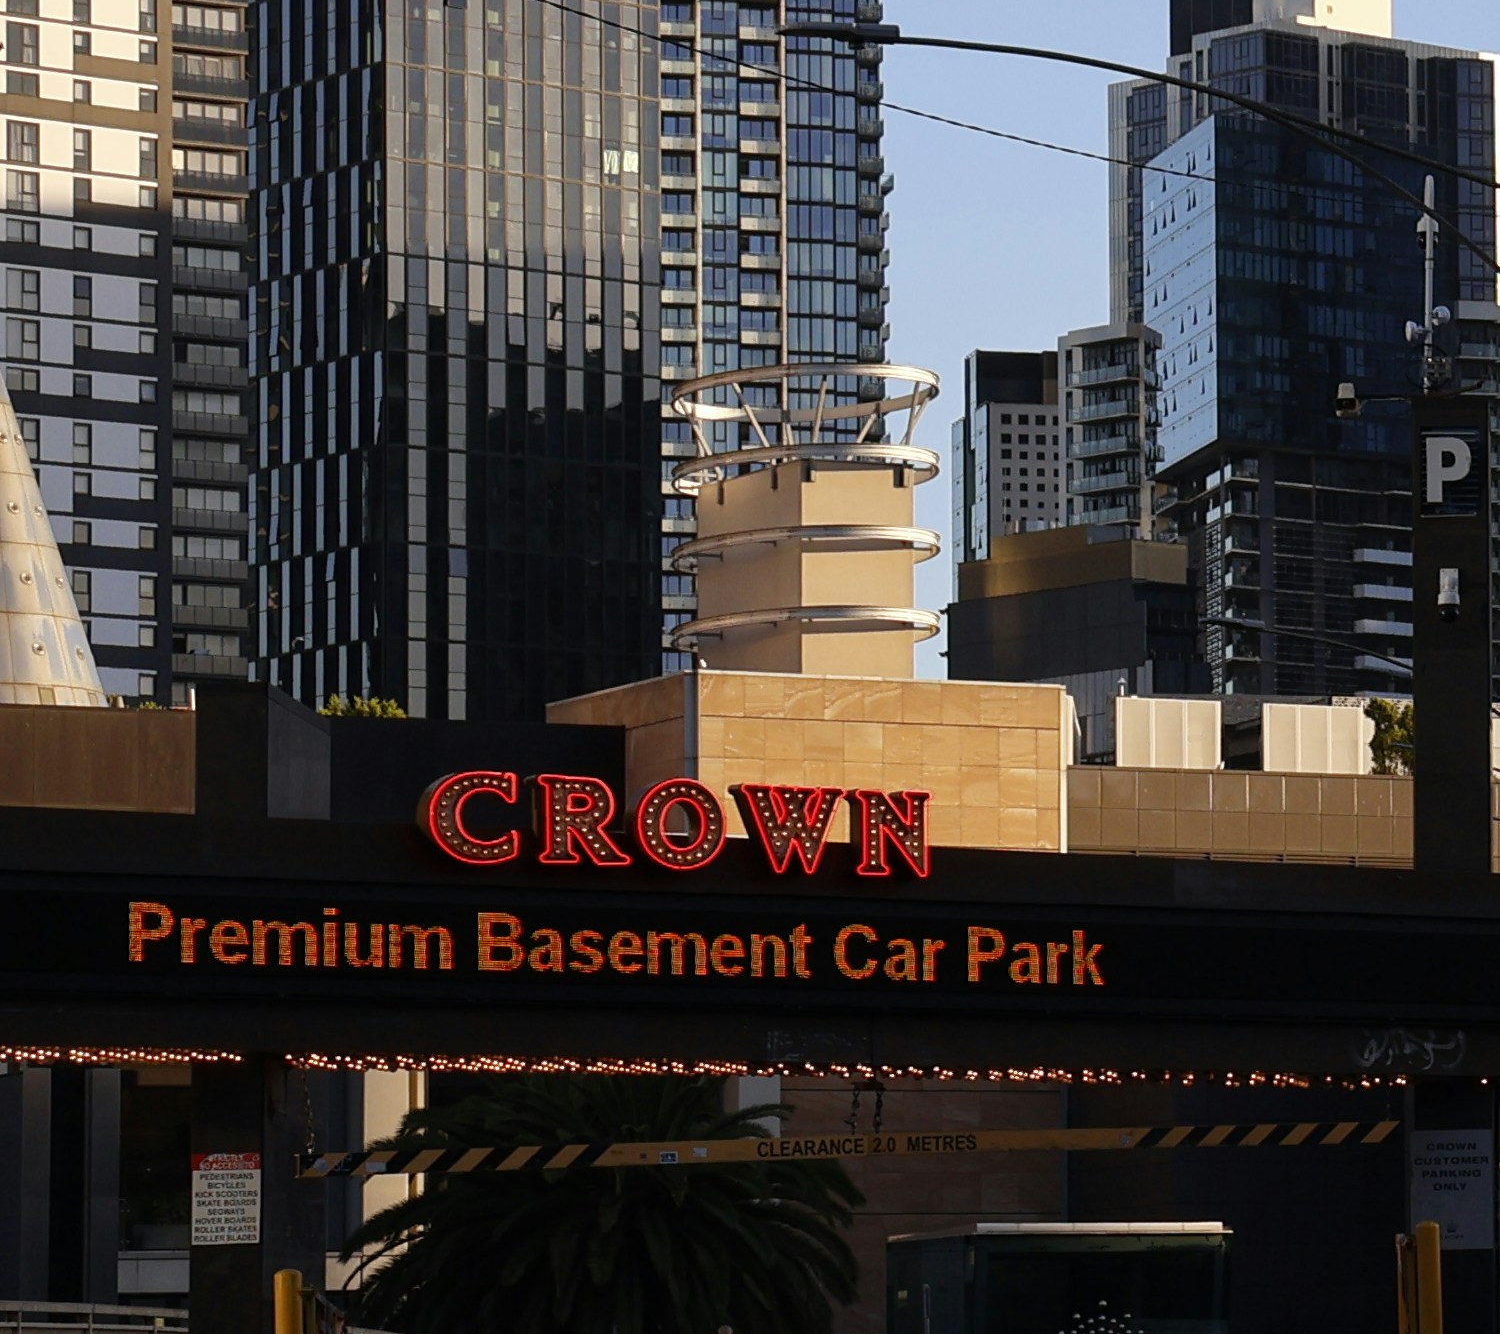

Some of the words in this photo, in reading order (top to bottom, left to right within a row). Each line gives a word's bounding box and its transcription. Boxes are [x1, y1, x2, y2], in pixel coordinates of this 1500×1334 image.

[1425, 437, 1472, 504] P
[421, 771, 932, 878] CROWN
[130, 902, 453, 969] Premium
[478, 913, 812, 978] Basement
[834, 924, 945, 981] Car
[968, 927, 1104, 985] Park
[757, 1138, 864, 1158] CLEARANCE
[872, 1137, 896, 1153] 2.0
[906, 1135, 977, 1152] METRES
[1426, 1142, 1477, 1152] CROWN
[1414, 1156, 1489, 1165] CUSTOMER
[1421, 1170, 1482, 1178] PARKING
[1433, 1183, 1468, 1191] ONLY
[216, 1190, 258, 1198] SCOOTERS
[207, 1208, 245, 1216] SEGWAYS
[194, 1226, 225, 1234] ROLLER
[227, 1234, 257, 1242] BLADES
